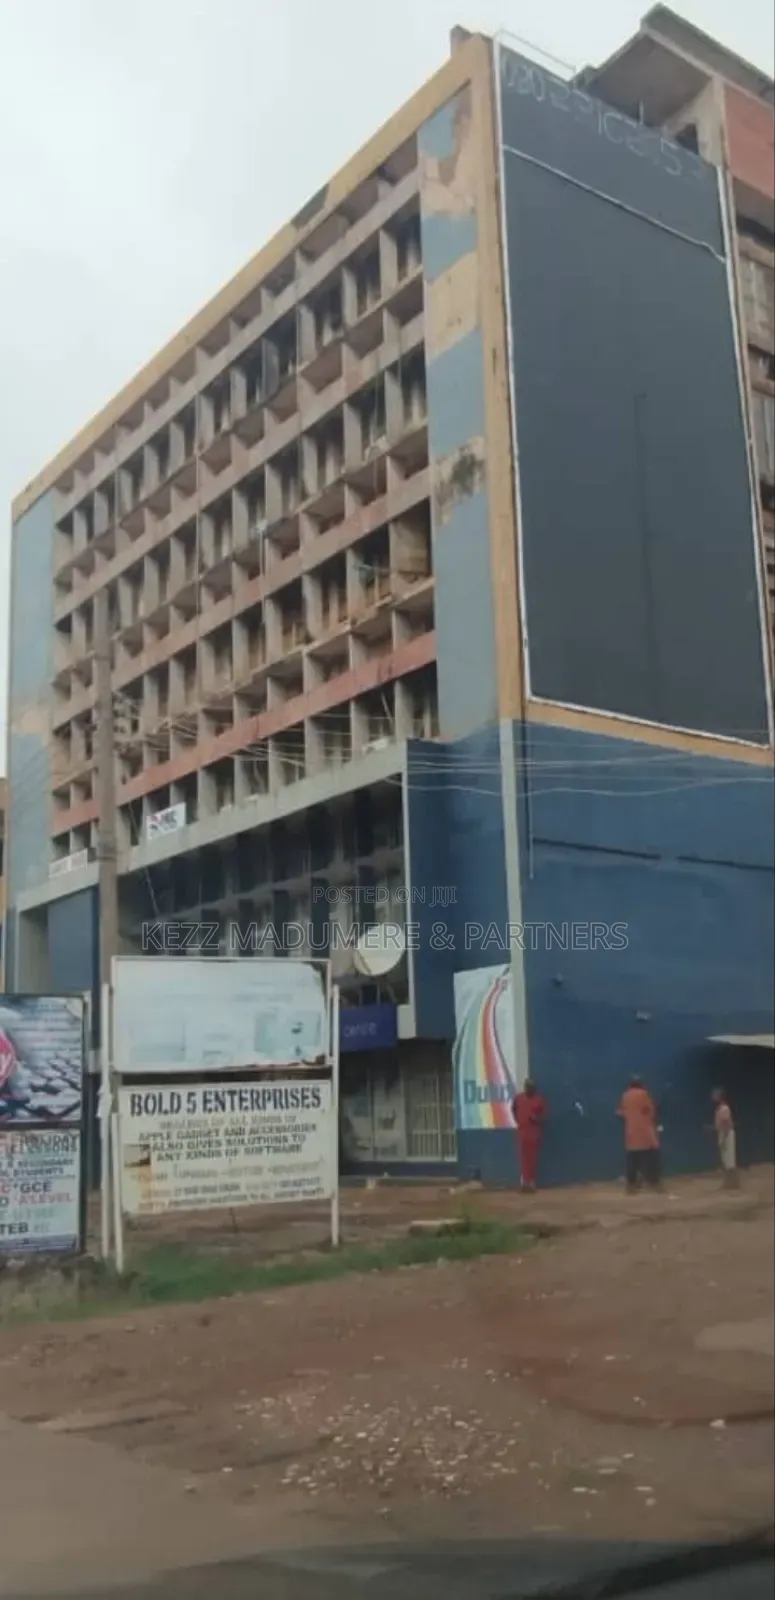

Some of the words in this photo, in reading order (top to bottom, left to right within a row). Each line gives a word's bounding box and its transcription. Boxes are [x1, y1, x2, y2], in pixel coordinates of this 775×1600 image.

[130, 1091, 182, 1117] BOLD
[186, 1091, 197, 1115] 5
[202, 1086, 322, 1114] ENTERPRISES
[139, 1131, 172, 1142] APPLE
[224, 1127, 245, 1137] AND
[187, 1138, 222, 1150] GIVES
[292, 1133, 306, 1144] TO
